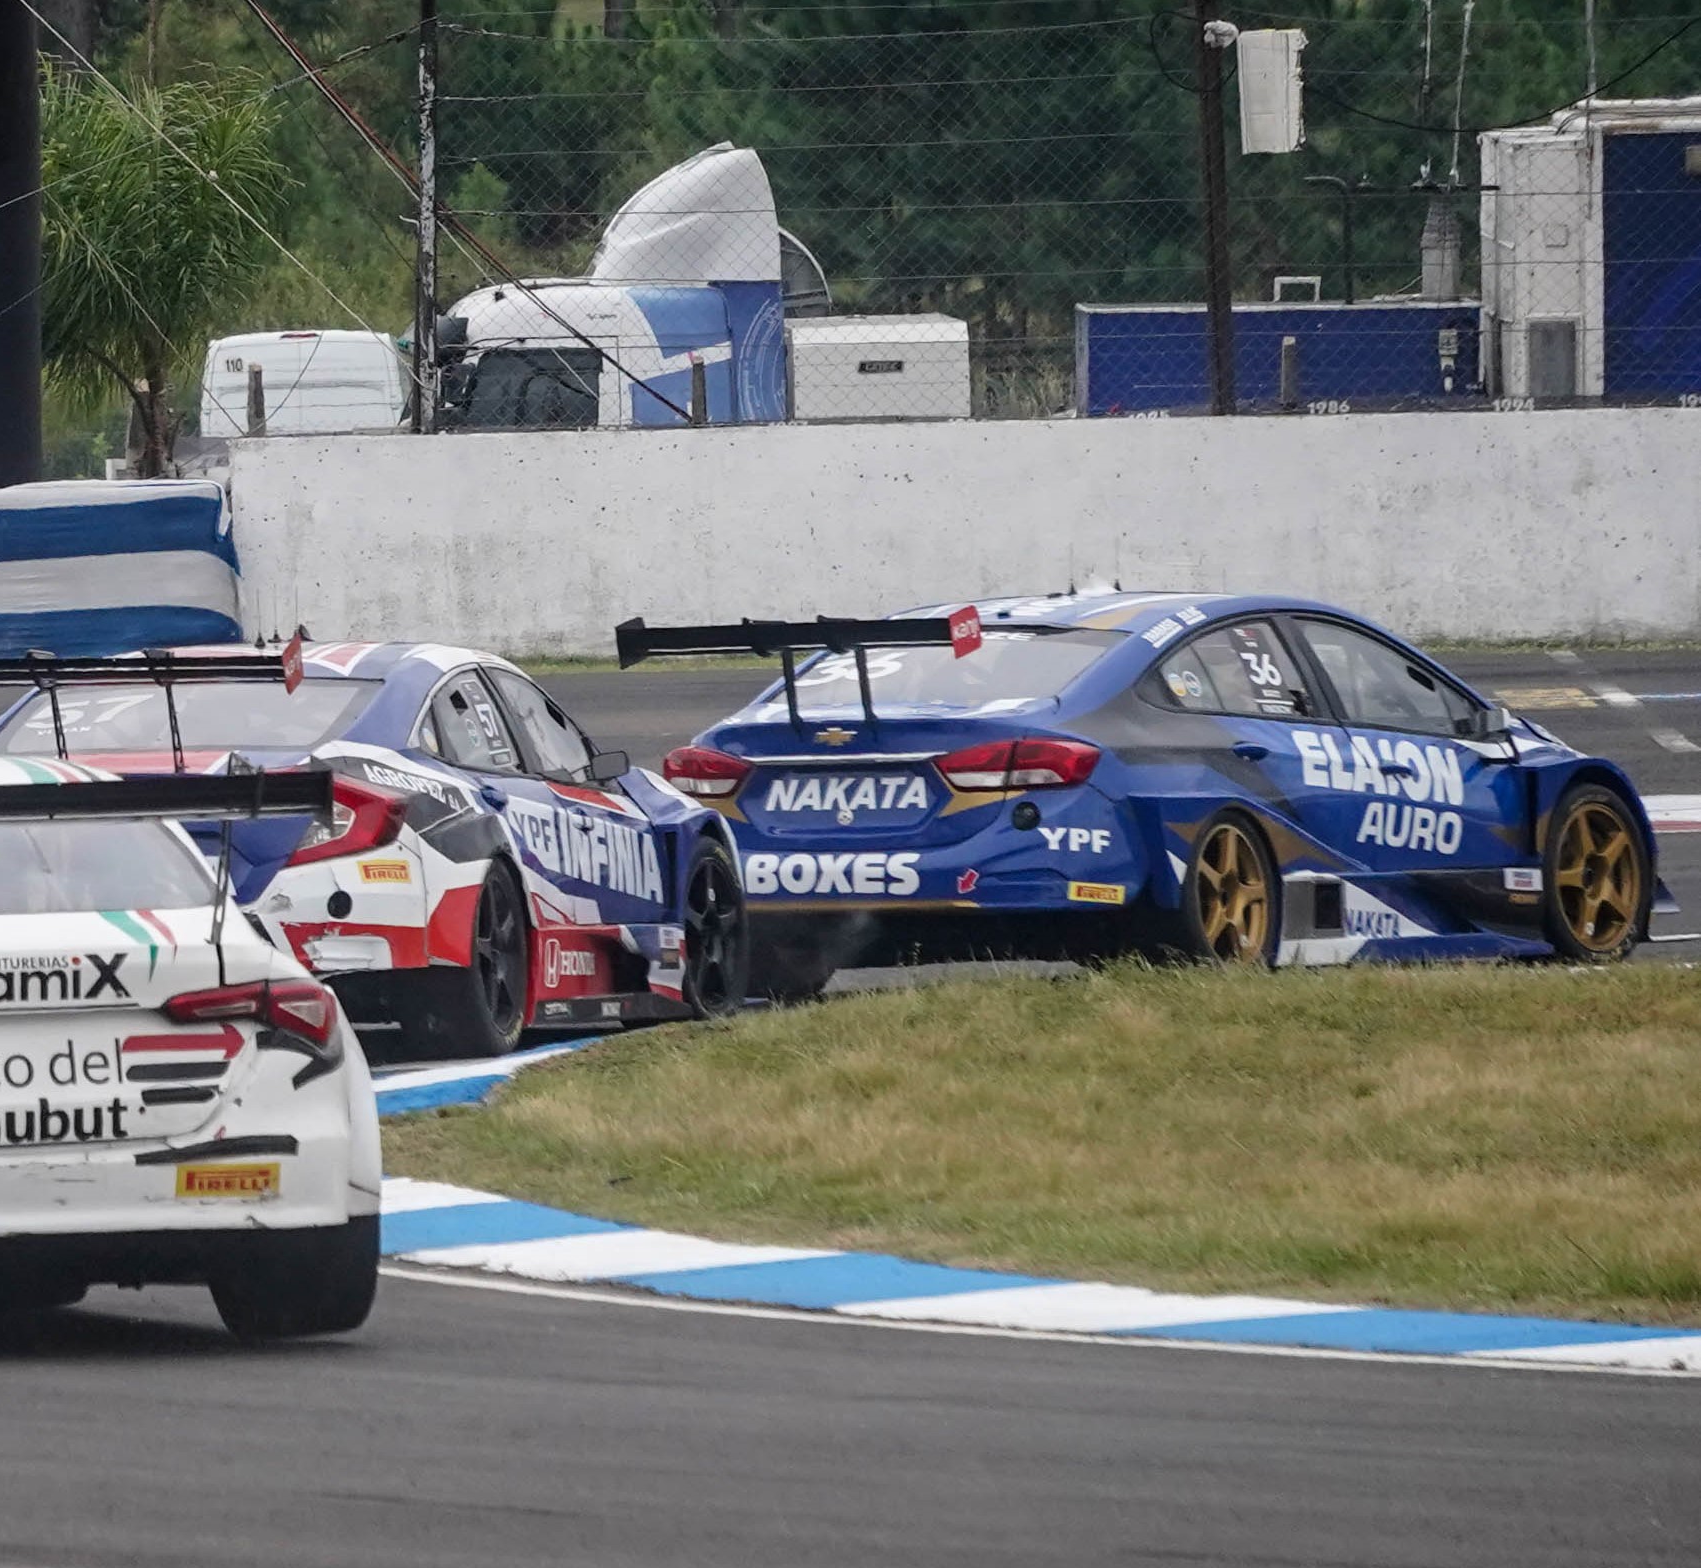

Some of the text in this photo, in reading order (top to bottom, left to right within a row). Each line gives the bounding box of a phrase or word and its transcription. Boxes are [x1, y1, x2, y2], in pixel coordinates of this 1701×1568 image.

[225, 357, 244, 373] 110
[1306, 399, 1351, 415] 1986
[1239, 652, 1283, 687] 36
[24, 693, 155, 729] 57
[764, 776, 929, 812] NAKATA
[1036, 826, 1112, 854] YPF
[1355, 801, 1463, 856] AURO
[362, 863, 410, 881] PIRELLI
[511, 807, 664, 904] YPF INFINIA
[744, 852, 922, 896] BOXES
[49, 1037, 124, 1086] del
[185, 1168, 273, 1194] PIRELLI
